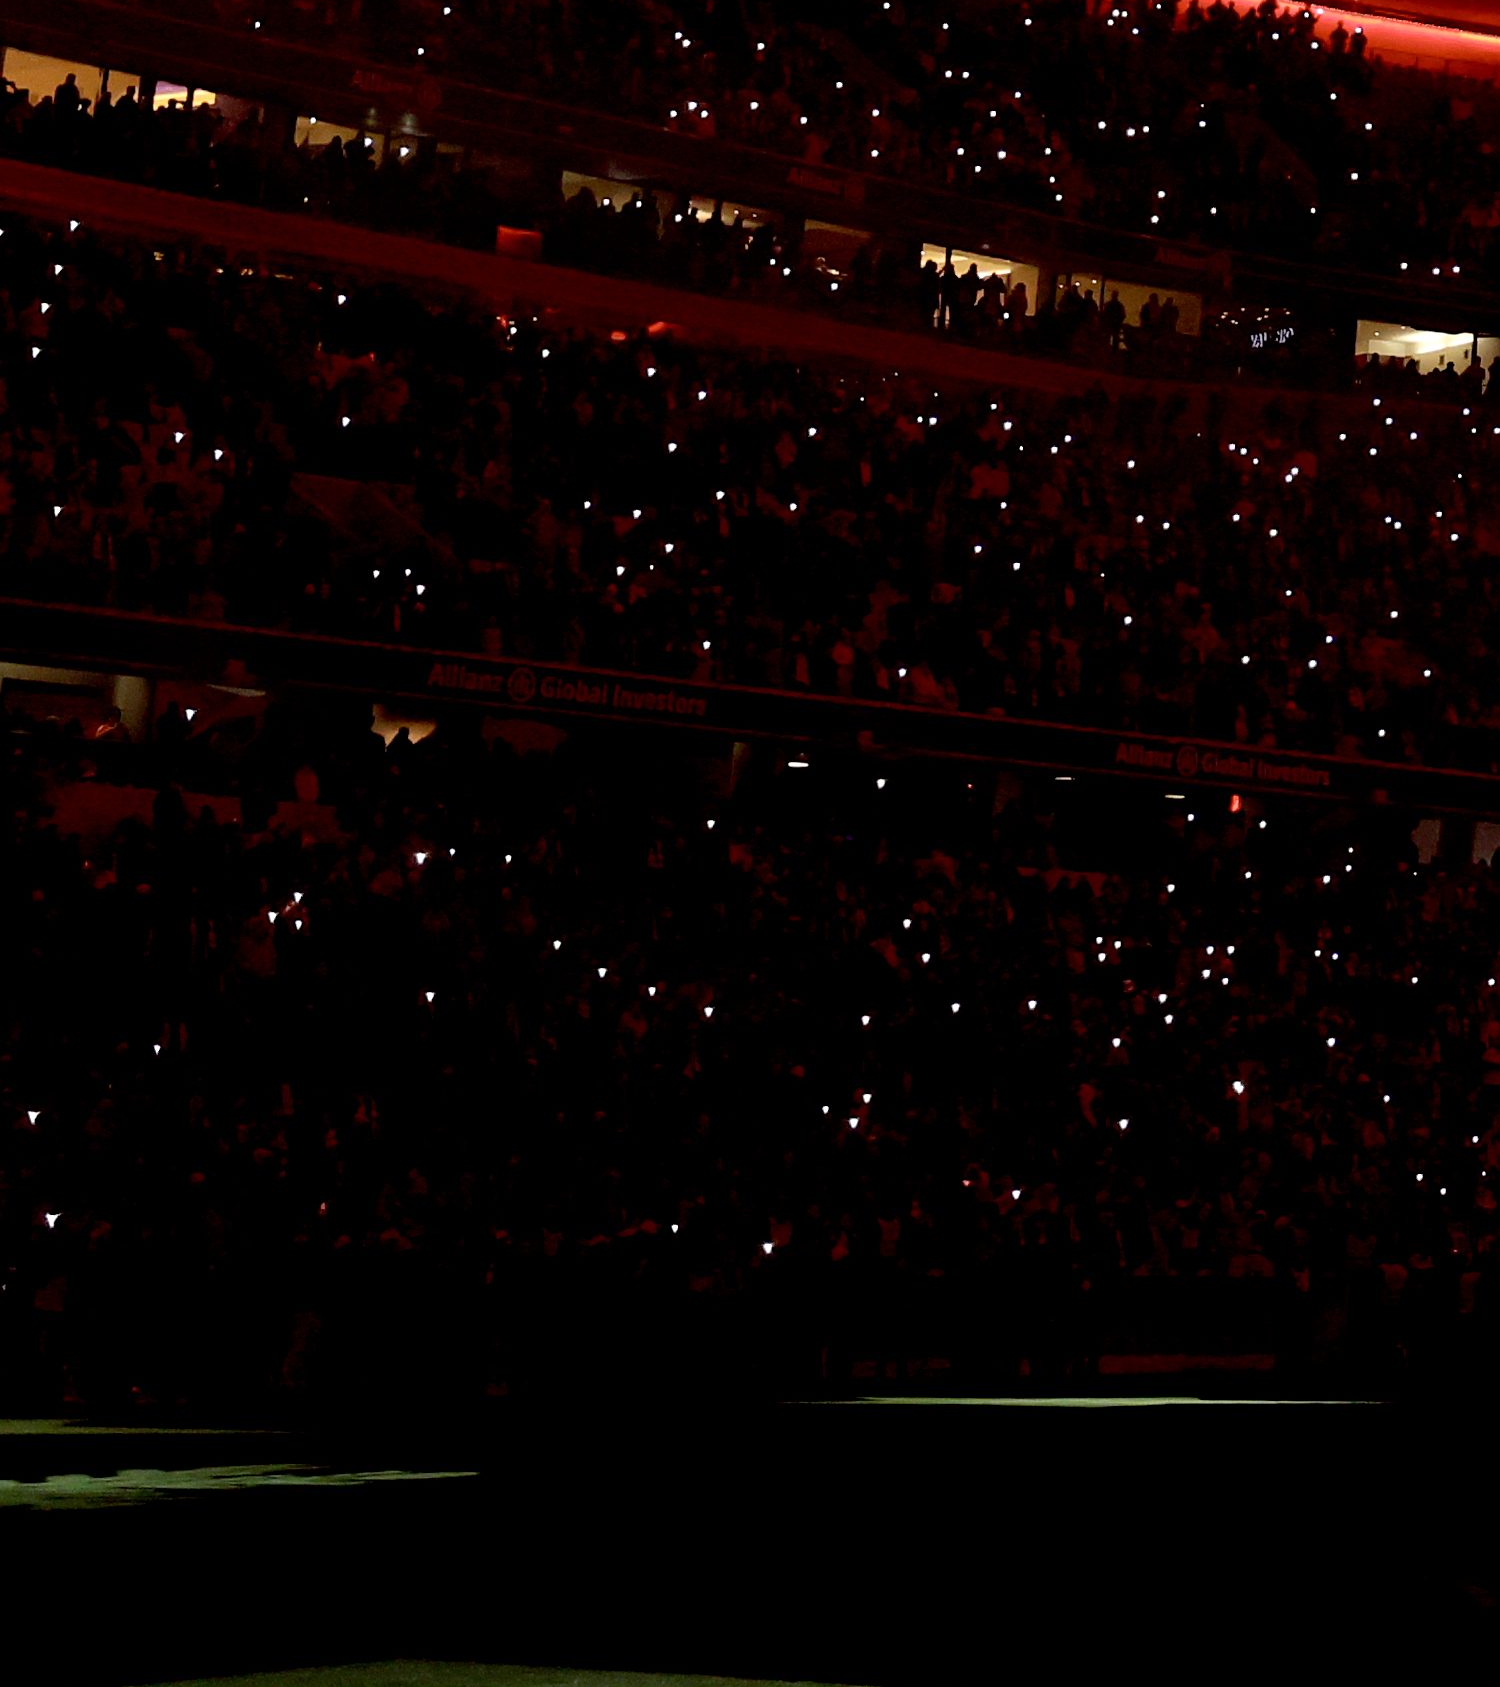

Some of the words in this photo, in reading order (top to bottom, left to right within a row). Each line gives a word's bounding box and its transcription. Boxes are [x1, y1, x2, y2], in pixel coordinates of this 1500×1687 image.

[428, 664, 504, 694] Allianz
[540, 676, 609, 706] Global
[613, 684, 708, 717] Investors
[1115, 743, 1173, 770] Allianz
[1201, 752, 1256, 778] Global
